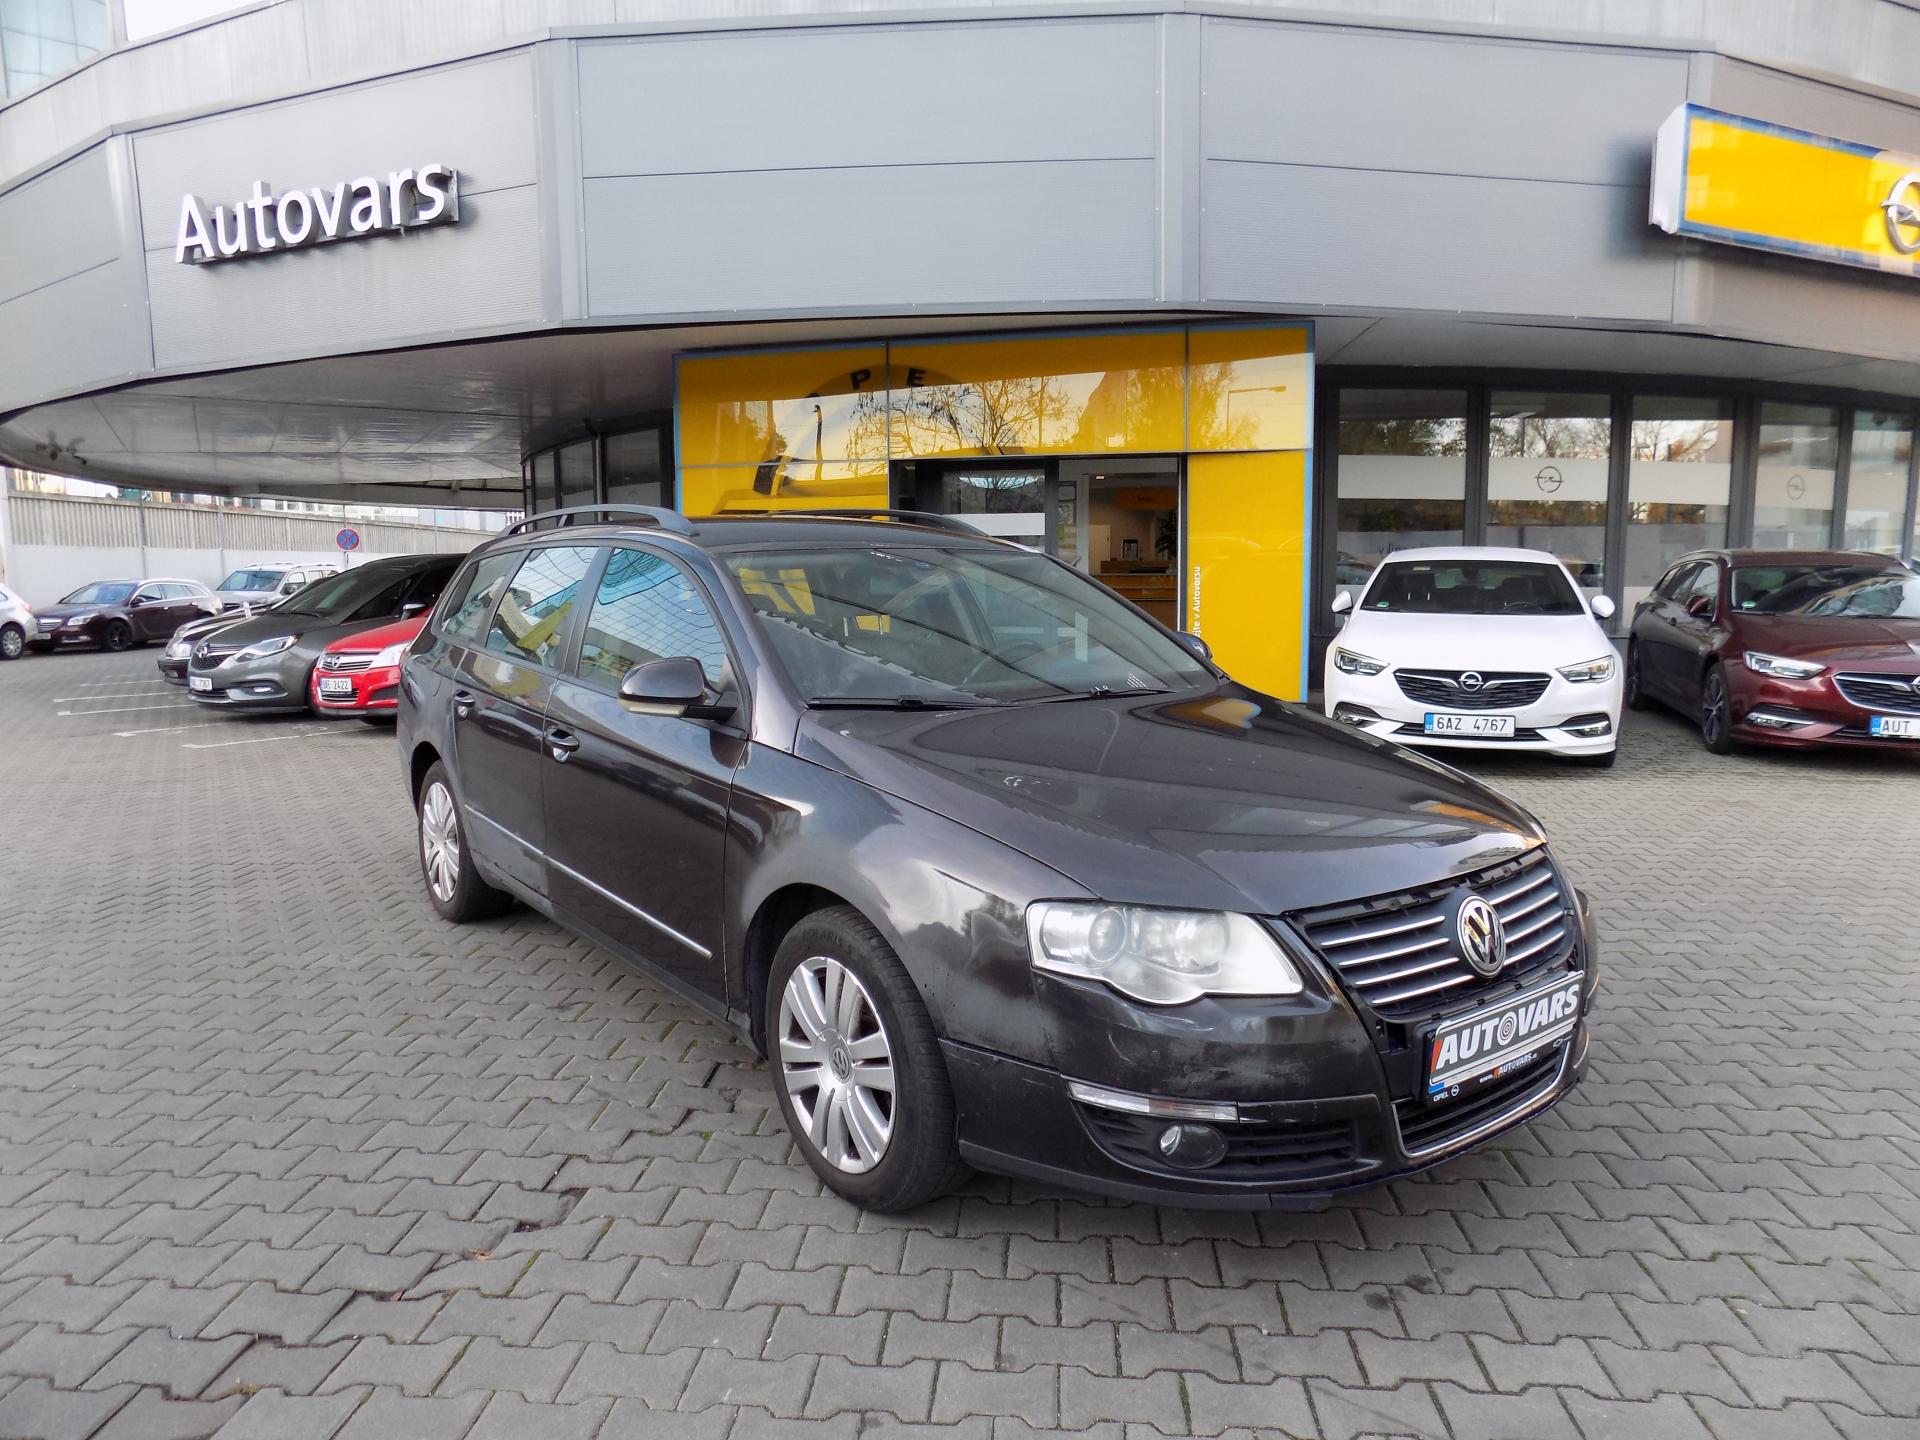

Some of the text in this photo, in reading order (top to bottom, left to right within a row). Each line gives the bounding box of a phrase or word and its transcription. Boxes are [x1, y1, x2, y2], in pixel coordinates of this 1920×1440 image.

[175, 163, 446, 264] Autovars
[1192, 566, 1201, 612] Autovarsu
[1437, 717, 1507, 731] 6AZ 4767
[1882, 720, 1910, 733] AUT
[1435, 984, 1580, 1070] AUTOVARS
[1433, 1091, 1450, 1102] OPEL
